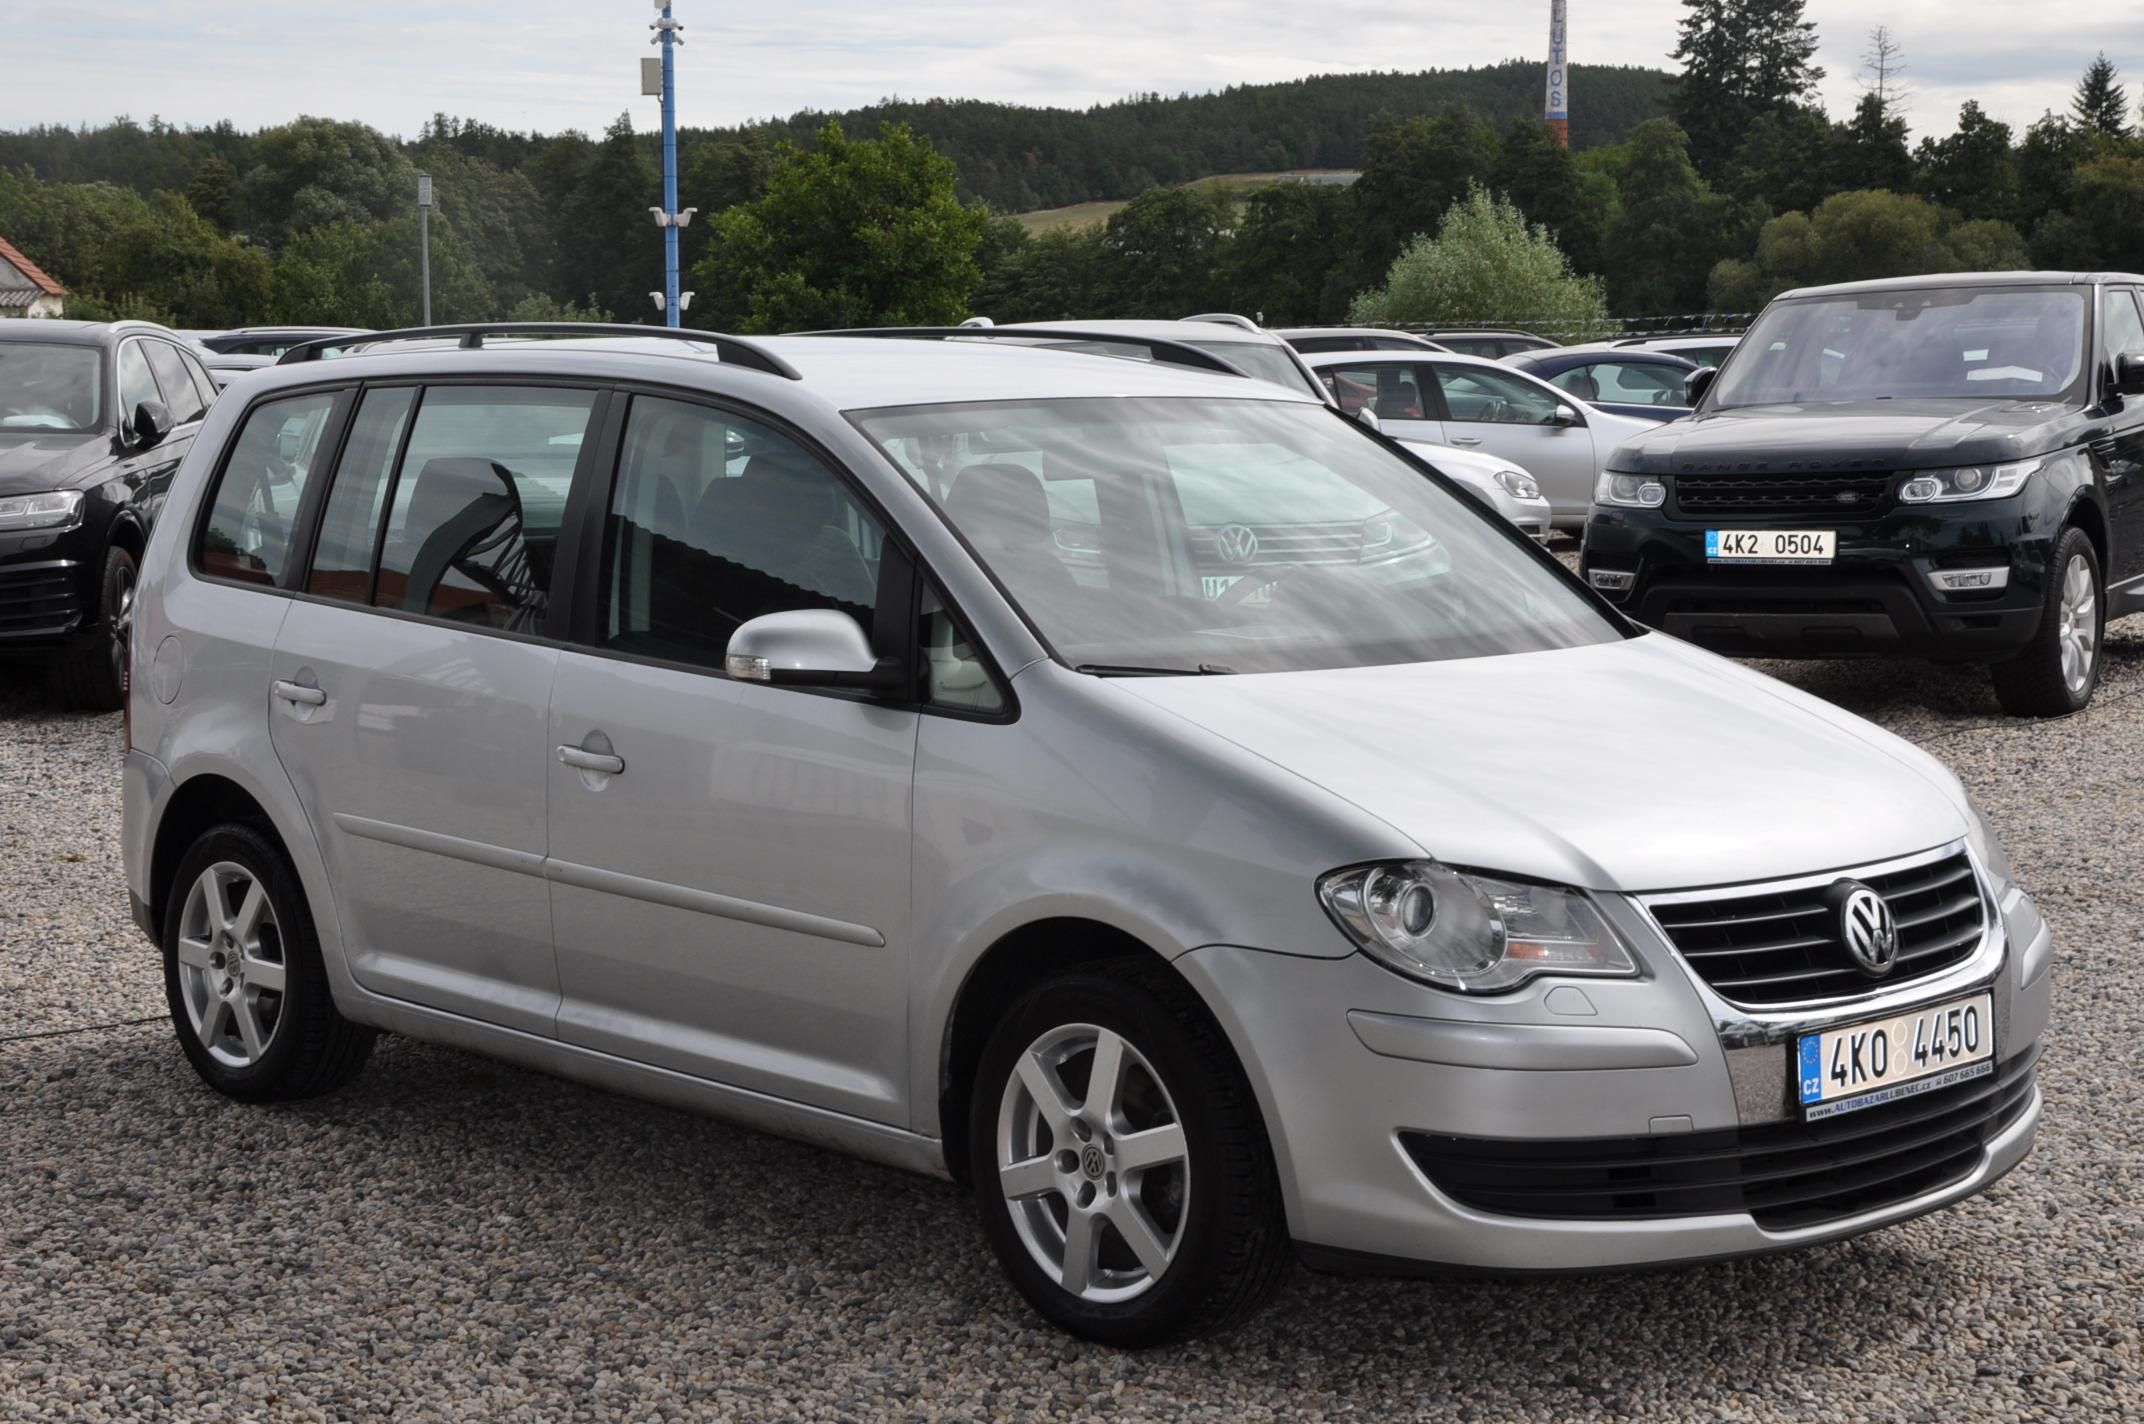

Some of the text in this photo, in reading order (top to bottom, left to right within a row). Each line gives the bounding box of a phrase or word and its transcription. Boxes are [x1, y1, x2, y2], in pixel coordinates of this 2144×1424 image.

[1723, 534, 1824, 554] 4K2 0504
[1830, 1005, 1979, 1088] 4K0 4450
[1803, 1078, 1820, 1095] CZ
